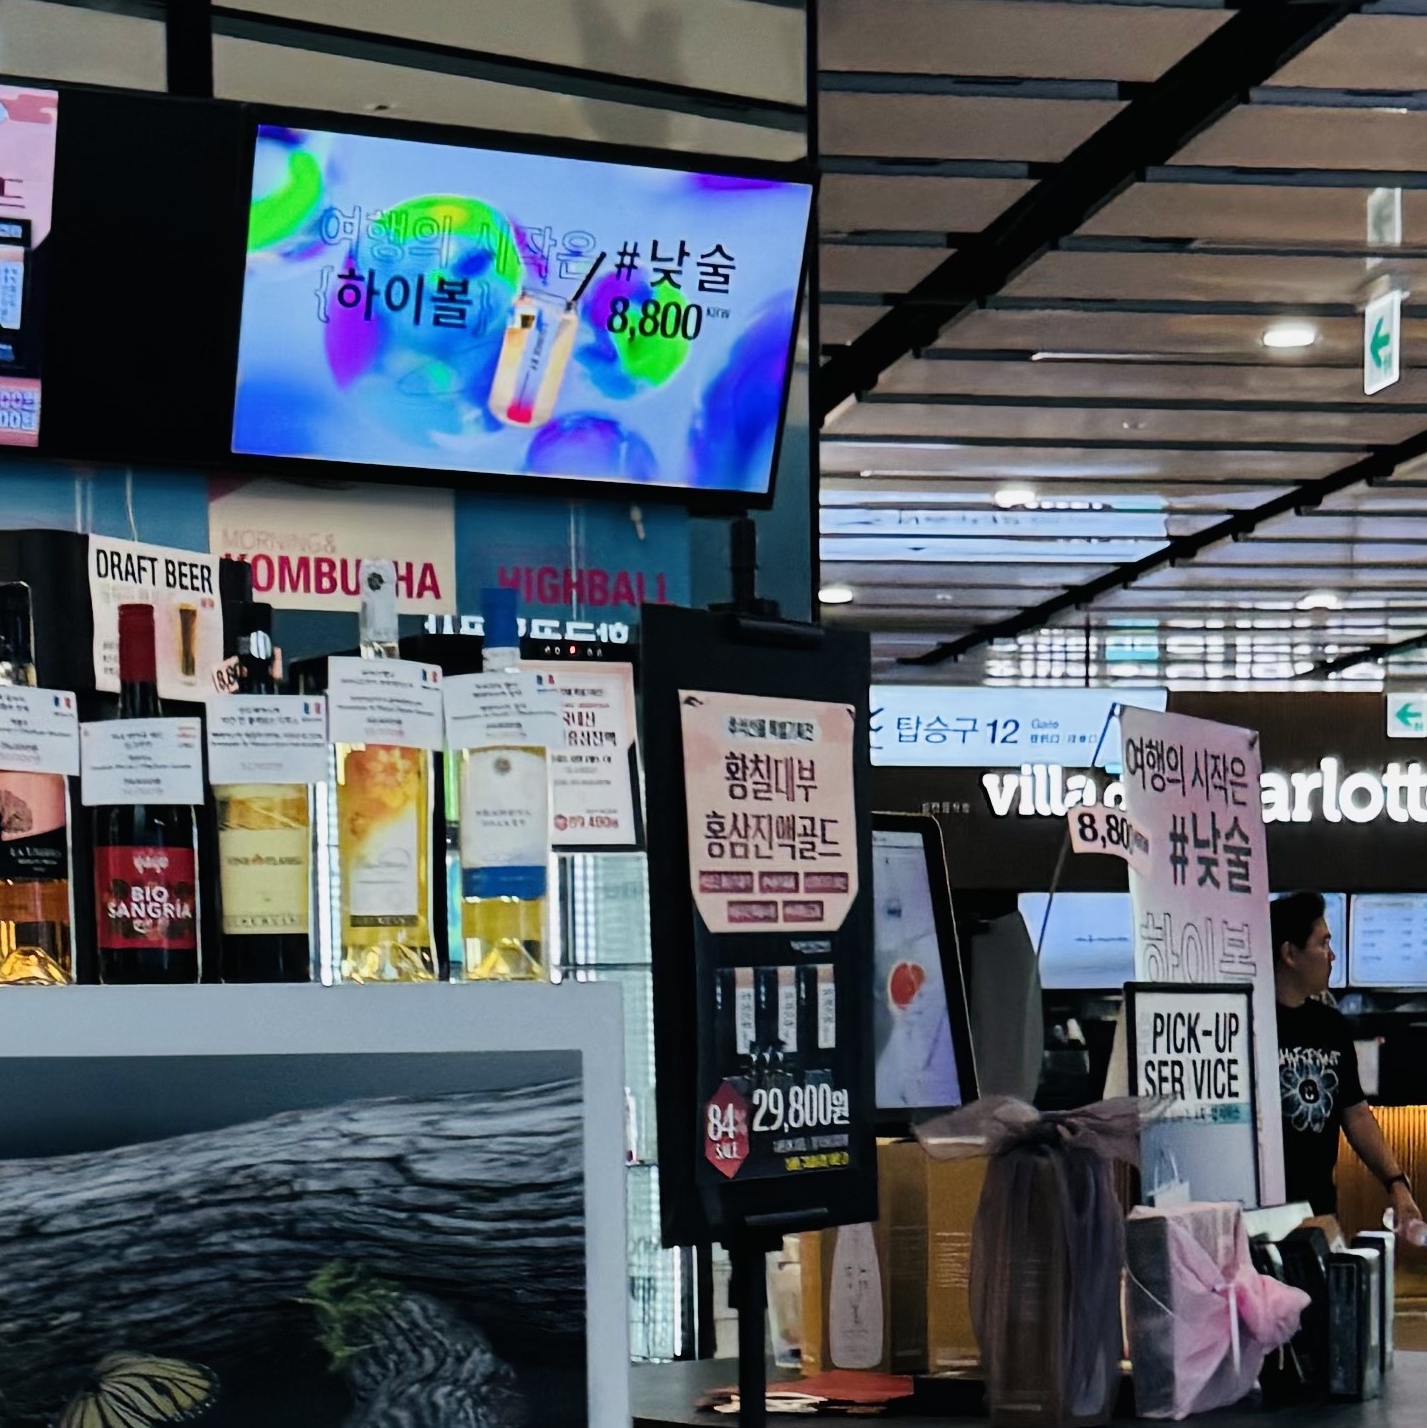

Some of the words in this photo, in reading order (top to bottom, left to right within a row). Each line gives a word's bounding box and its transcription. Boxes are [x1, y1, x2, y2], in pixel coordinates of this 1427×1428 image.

[322, 206, 452, 269] 여행의
[476, 222, 596, 286] 시작은
[606, 296, 704, 342] 8,800
[96, 549, 158, 587] DRAFT
[165, 558, 214, 595] BEER
[225, 553, 441, 600] OMBUHA
[896, 715, 979, 745] 탑승구
[986, 719, 1021, 745] 12
[724, 751, 818, 803] 황칠대부
[982, 764, 1097, 816] villa
[1125, 736, 1187, 797] 여행의
[1191, 748, 1249, 808] 시작은
[704, 810, 842, 861] 홍삼진액골드
[131, 885, 170, 903] BIO
[1153, 1011, 1240, 1055] PICK-UP
[752, 1083, 851, 1133] 29,800원
